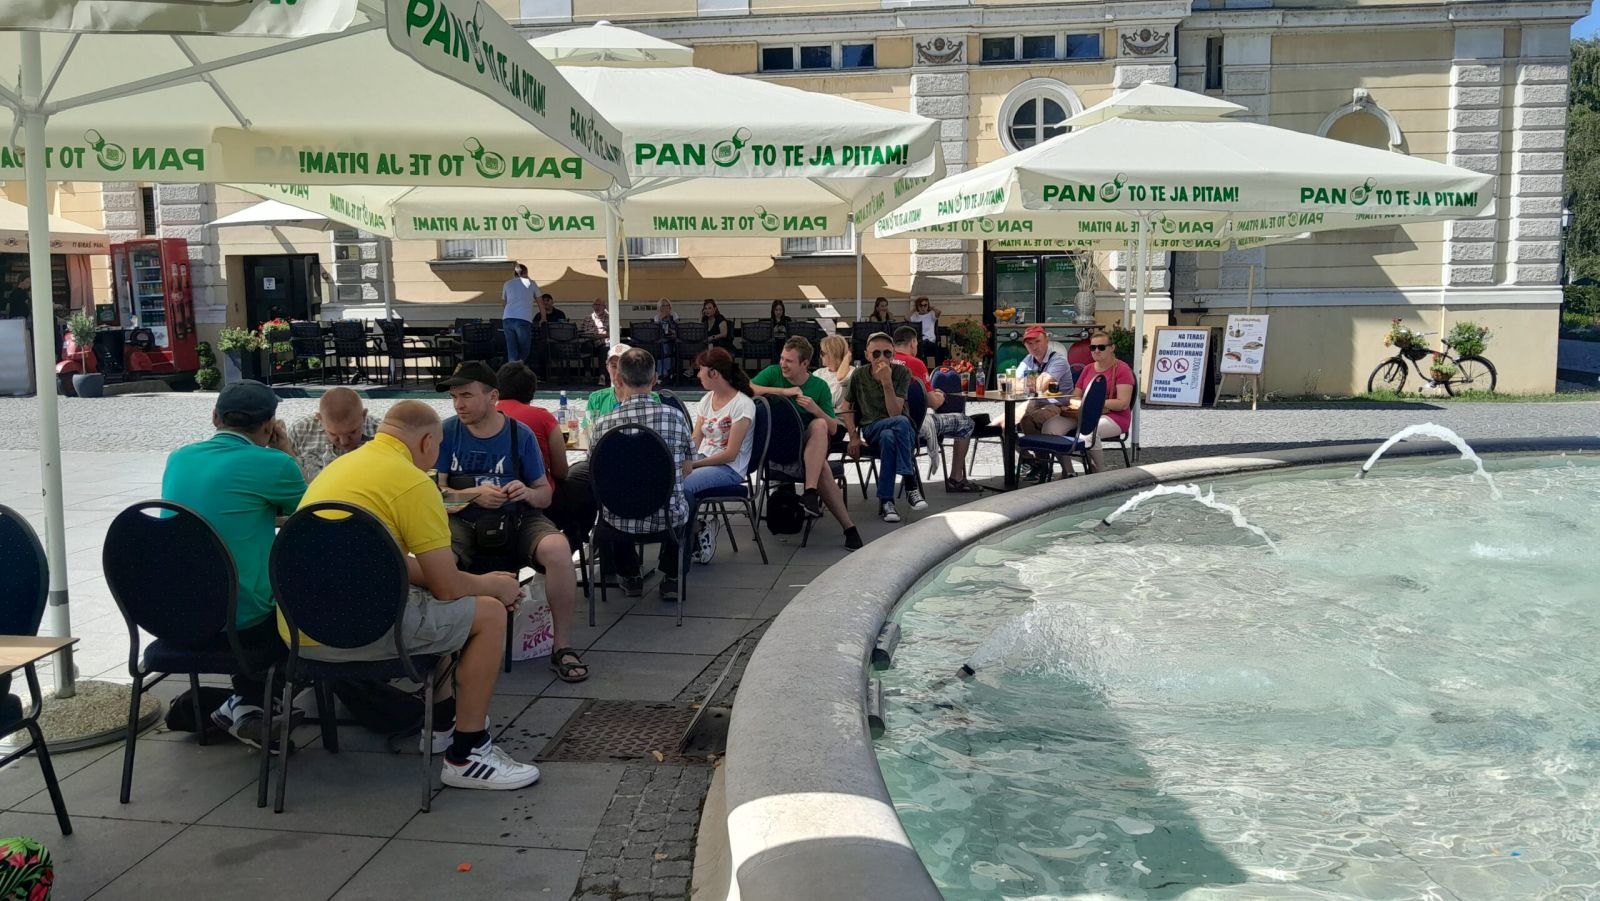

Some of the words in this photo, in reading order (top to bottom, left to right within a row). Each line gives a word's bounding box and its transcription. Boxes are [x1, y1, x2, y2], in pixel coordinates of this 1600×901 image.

[406, 0, 470, 63] PAN
[482, 40, 499, 82] TO
[497, 51, 509, 92] TE
[509, 62, 521, 101] JA
[522, 69, 546, 118] PITAM!
[570, 106, 587, 147] PAN
[635, 143, 706, 166] PAN
[752, 145, 777, 166] TO
[783, 145, 804, 166] TE
[809, 145, 836, 167] JA
[842, 144, 909, 166] PITAM!
[1043, 184, 1096, 202] PAN
[1128, 186, 1146, 202] TO
[1150, 186, 1166, 202] TE
[1170, 186, 1189, 202] JA
[1192, 186, 1240, 203] PITAM!
[1300, 187, 1347, 205] PAN
[1376, 190, 1393, 205] TO
[1396, 190, 1410, 205] TE
[1413, 191, 1431, 206] JA
[1435, 191, 1479, 207] PITAM!
[937, 199, 954, 216] PAN
[523, 624, 554, 651] KRK
